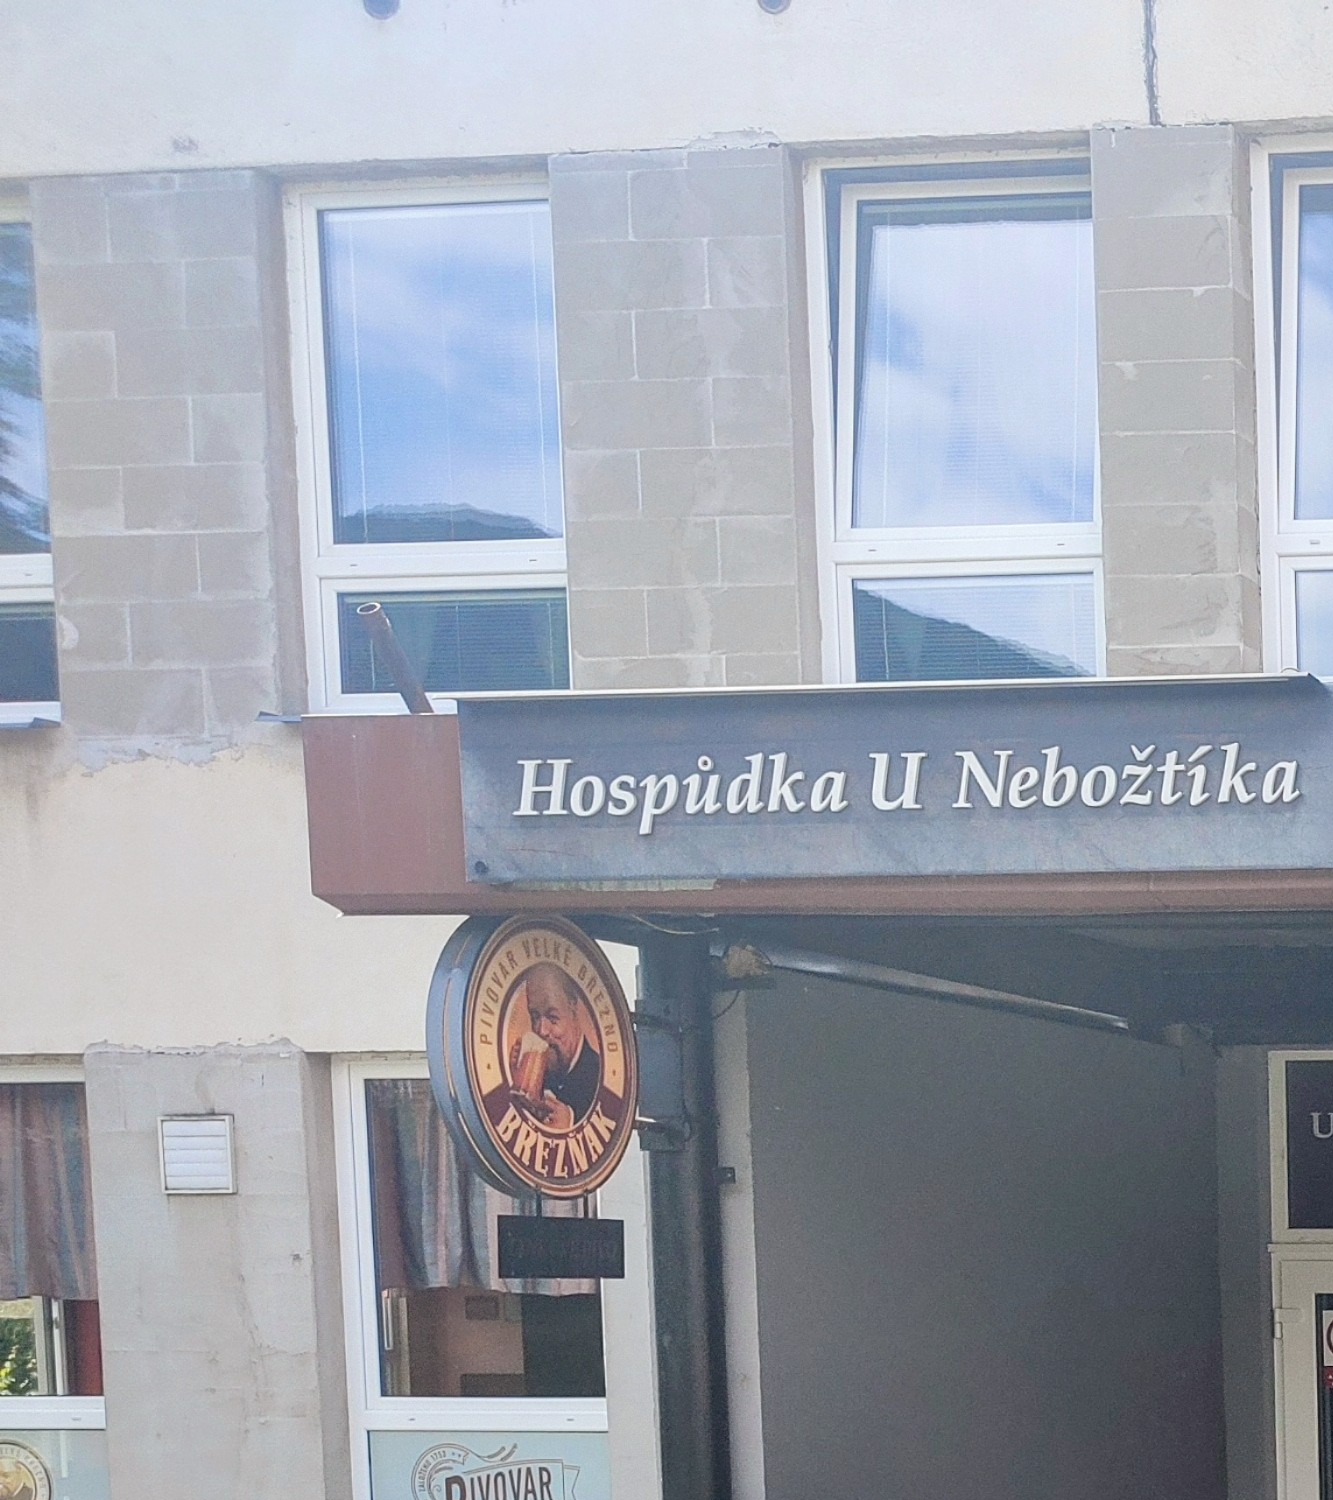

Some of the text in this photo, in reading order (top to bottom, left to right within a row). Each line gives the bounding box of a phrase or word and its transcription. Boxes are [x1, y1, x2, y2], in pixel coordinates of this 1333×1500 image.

[512, 742, 1302, 836] Hospůdka U Nebožtíka
[480, 948, 519, 1046] PIVOVAR
[495, 1104, 617, 1179] BŘEZŇÁK
